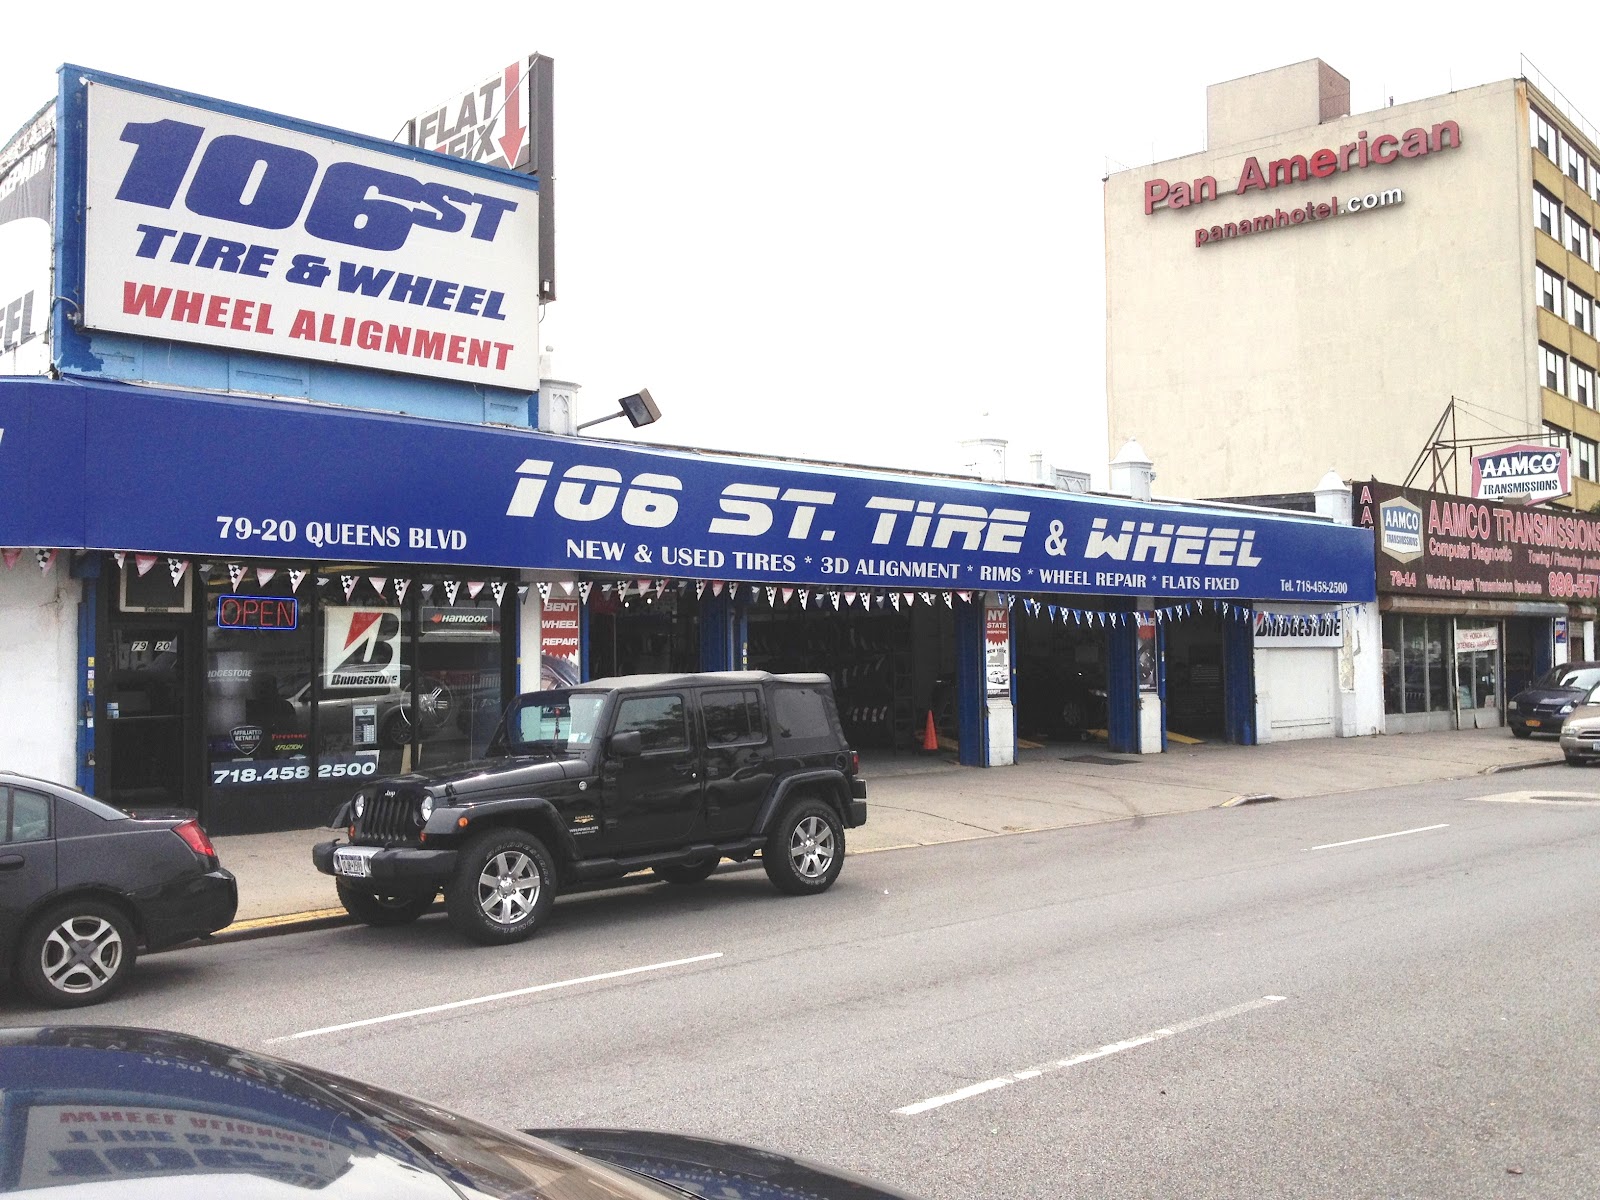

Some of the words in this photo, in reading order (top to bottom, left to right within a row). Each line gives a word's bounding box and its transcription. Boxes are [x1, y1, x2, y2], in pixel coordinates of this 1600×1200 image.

[418, 77, 502, 150] FLAT
[447, 117, 498, 161] FIX
[1144, 175, 1218, 216] Pan
[1236, 119, 1462, 196] American
[1194, 186, 1404, 248] panamhotel.com
[134, 223, 282, 279] TIRE
[284, 253, 333, 289] &
[337, 260, 507, 322] WHEEL
[122, 280, 275, 336] WHEEL
[288, 309, 515, 372] ALIGNMENT
[1481, 453, 1558, 478] AAMCO
[1482, 479, 1558, 495] TRANSMISSIONS
[505, 458, 684, 529] 106
[707, 482, 837, 542] ST.
[864, 495, 1032, 554] TIRE
[1044, 519, 1068, 557] &
[1083, 517, 1263, 568] WHEEL
[1385, 509, 1419, 531] AAMCO
[1427, 499, 1491, 541] AAMCO
[216, 515, 297, 543] 79-20
[305, 521, 401, 549] QUEENS
[408, 527, 467, 551] BLVD
[1386, 533, 1419, 547] TRANSMISSIONS
[1428, 537, 1471, 561] Computer
[1471, 542, 1513, 565] Diagnostic
[565, 538, 626, 562] NEW
[633, 544, 653, 564] &
[661, 546, 725, 569] USED
[731, 551, 796, 573] TIRES
[820, 556, 850, 575] 3D
[855, 558, 961, 580] ALIGNMENT
[979, 564, 1022, 582] RIMS
[1039, 568, 1091, 586] WHEEL
[1095, 571, 1147, 588] REPAIR
[1161, 575, 1201, 590] FLATS
[1204, 576, 1240, 591] FIXED
[1280, 578, 1294, 592] Tel.
[1296, 579, 1348, 594] 718-458-2500
[1390, 570, 1417, 587] 79-14
[1548, 571, 1600, 599] 898-557
[221, 598, 295, 627] OPEN
[543, 602, 578, 613] BENT
[987, 609, 1006, 622] NY
[541, 619, 579, 630] WHEEL
[986, 622, 1007, 630] STATE
[1255, 613, 1341, 637] BRIDGESTONE
[133, 641, 148, 651] 79
[156, 641, 171, 651] 20
[541, 637, 579, 647] REPAIR
[207, 669, 253, 678] IDGESTONE
[330, 673, 398, 687] BRIDGESTONE
[317, 761, 376, 779] 2500
